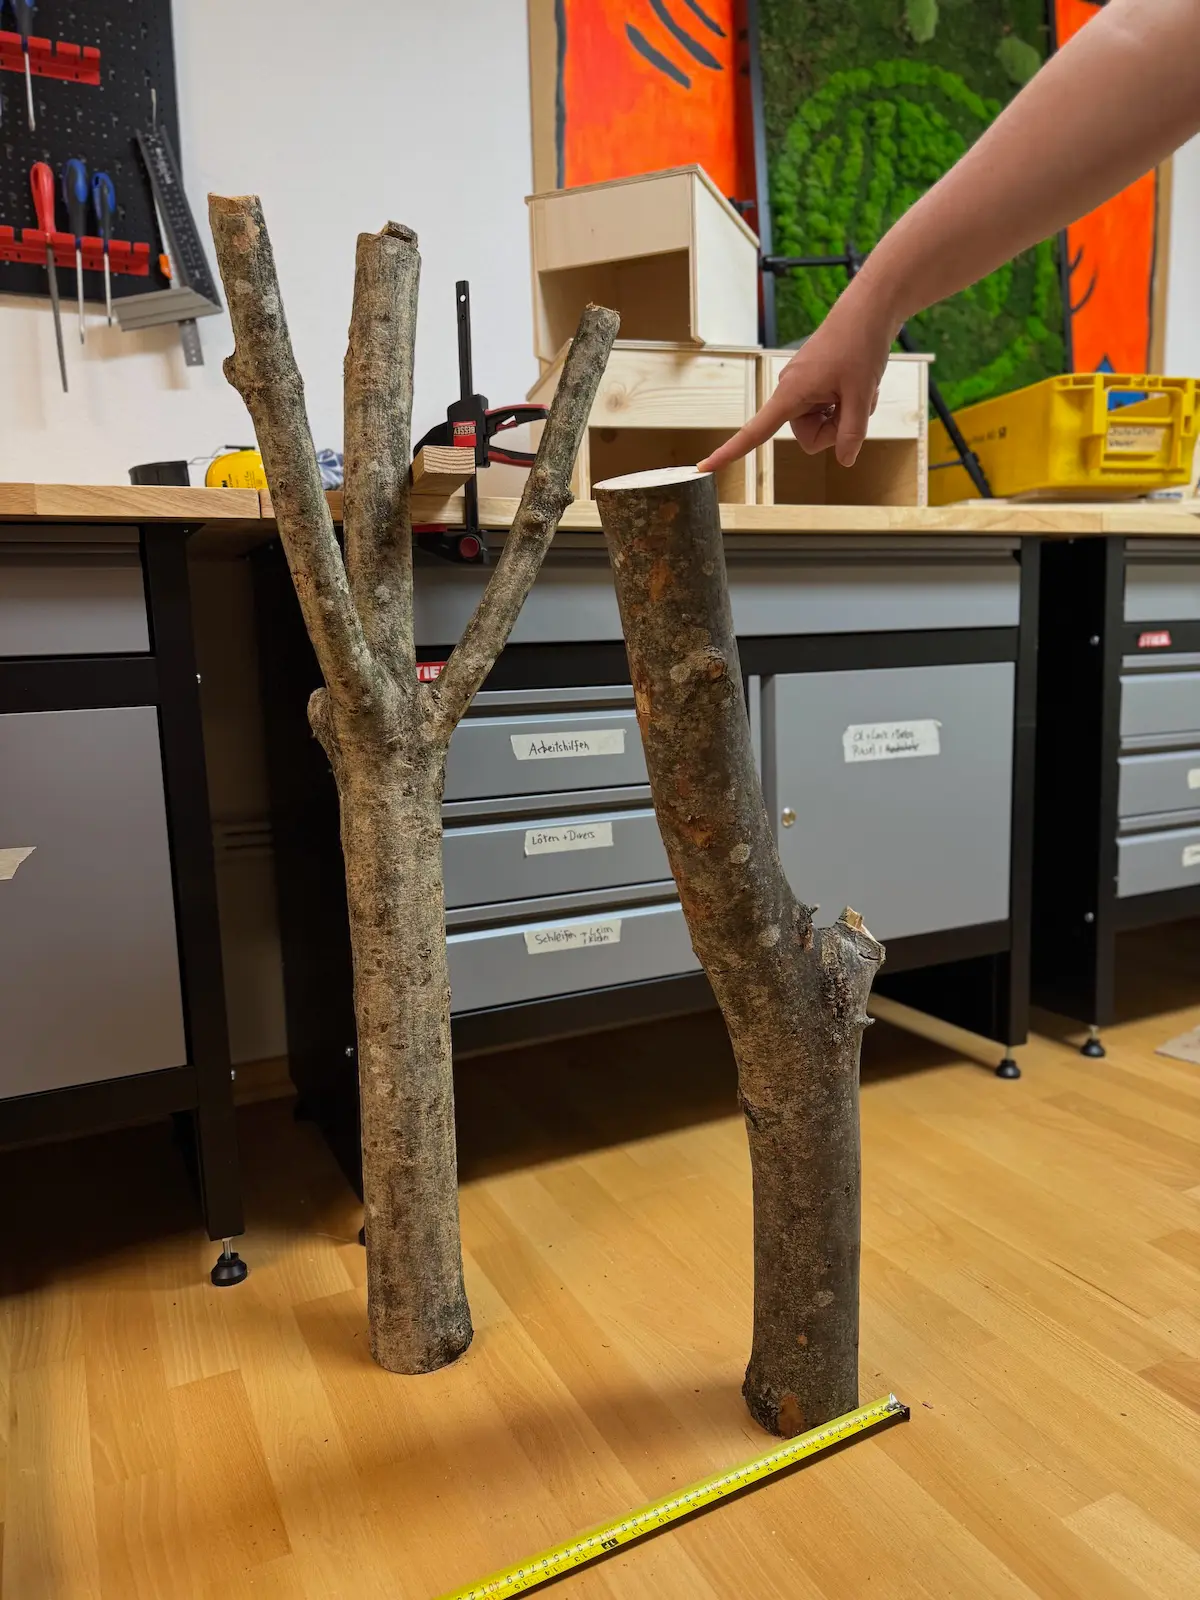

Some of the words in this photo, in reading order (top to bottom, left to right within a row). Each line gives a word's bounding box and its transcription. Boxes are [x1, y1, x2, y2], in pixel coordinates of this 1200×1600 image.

[453, 426, 476, 435] BESSEY
[416, 665, 445, 679] TIE
[528, 739, 590, 757] Arbeitshilfen
[532, 834, 560, 845] Löten
[658, 1514, 671, 1523] 10
[631, 1526, 644, 1536] 11
[573, 1553, 587, 1563] 13
[544, 1566, 558, 1576] 14
[514, 1580, 528, 1590] 15
